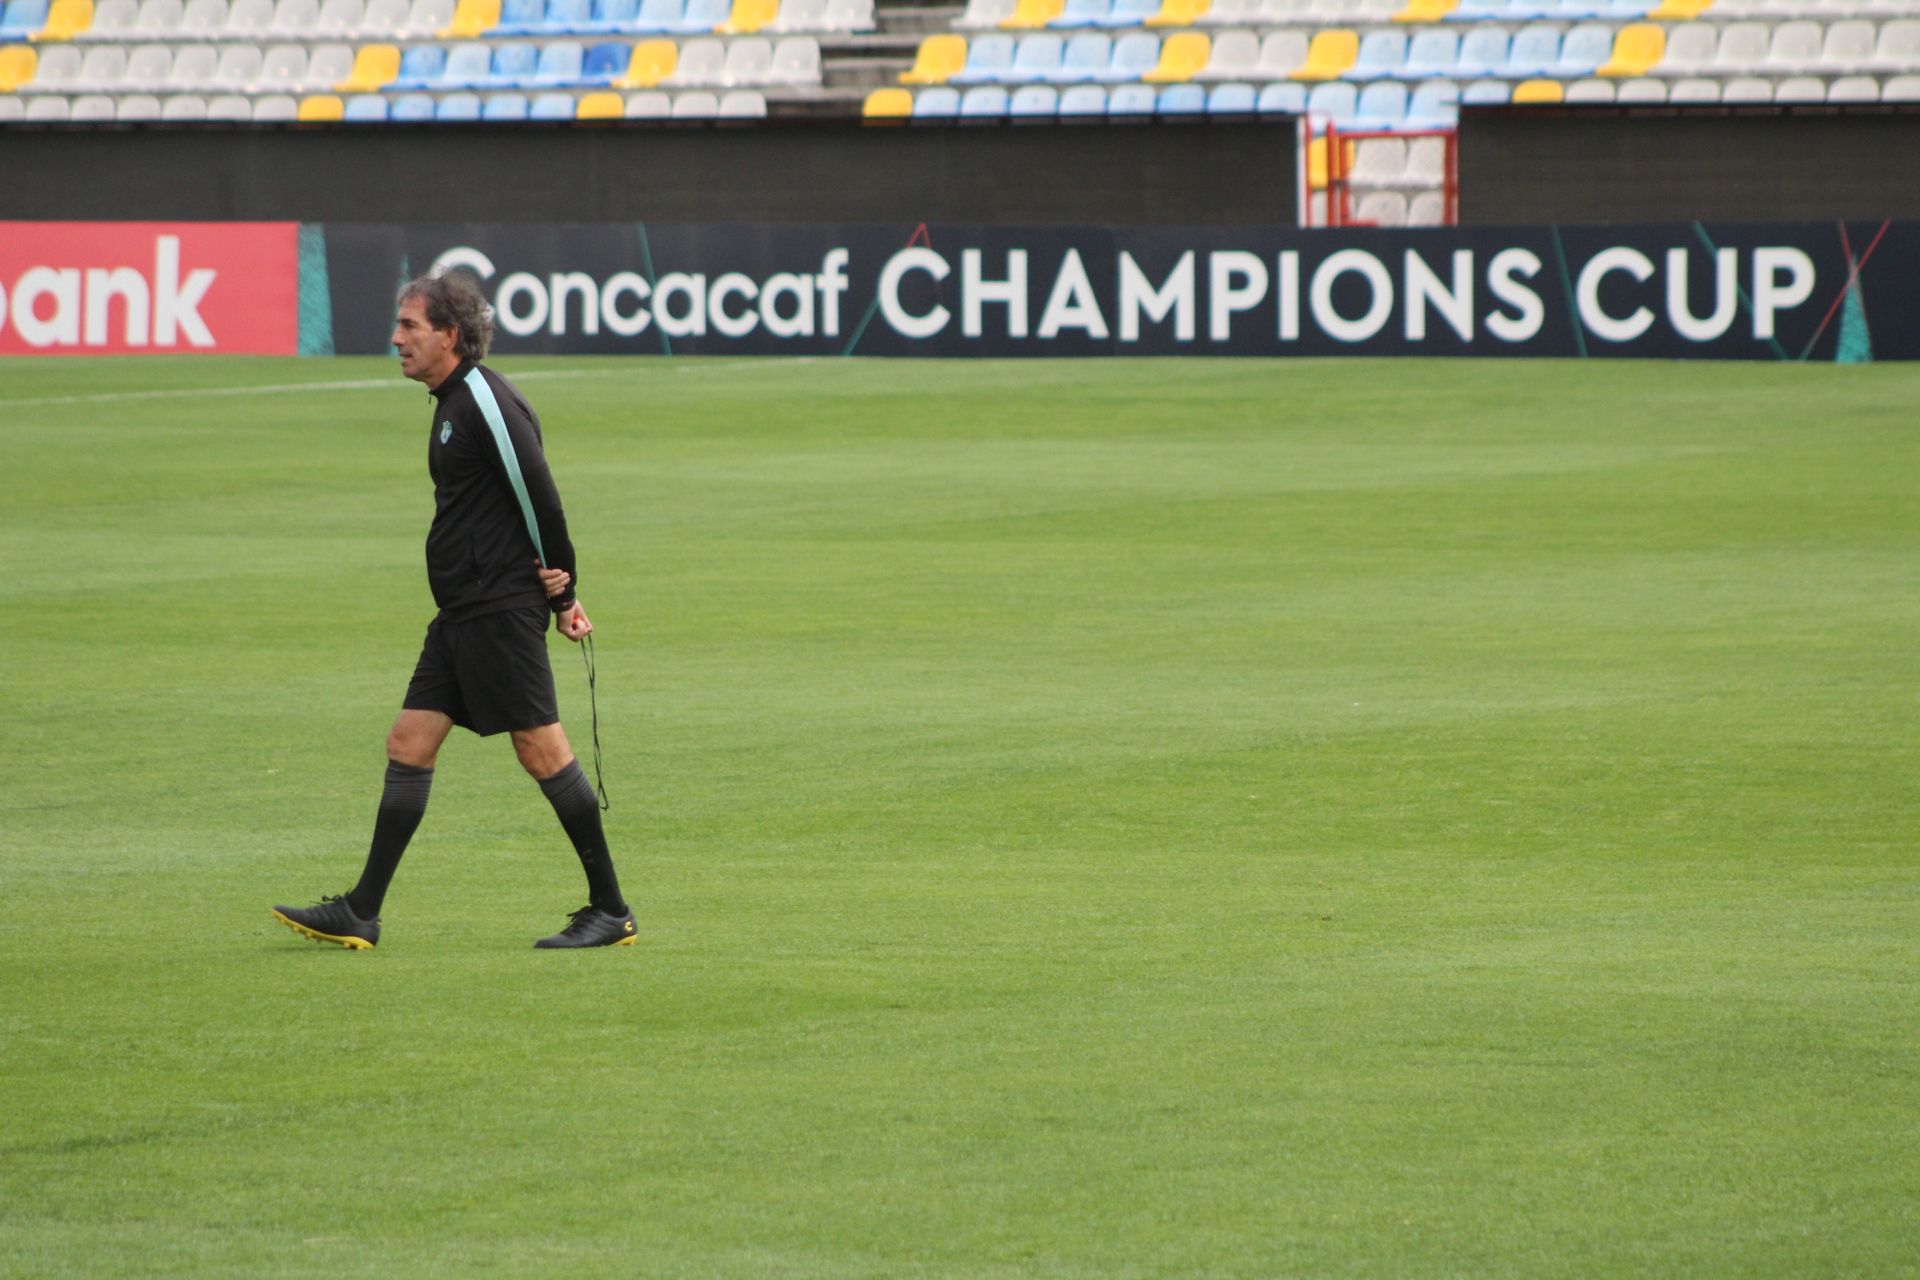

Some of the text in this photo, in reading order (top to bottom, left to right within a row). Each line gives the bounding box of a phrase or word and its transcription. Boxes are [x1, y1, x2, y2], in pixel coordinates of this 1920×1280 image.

[0, 234, 217, 347] ank
[877, 246, 1545, 343] CHAMPIONS
[1576, 245, 1816, 342] CUP
